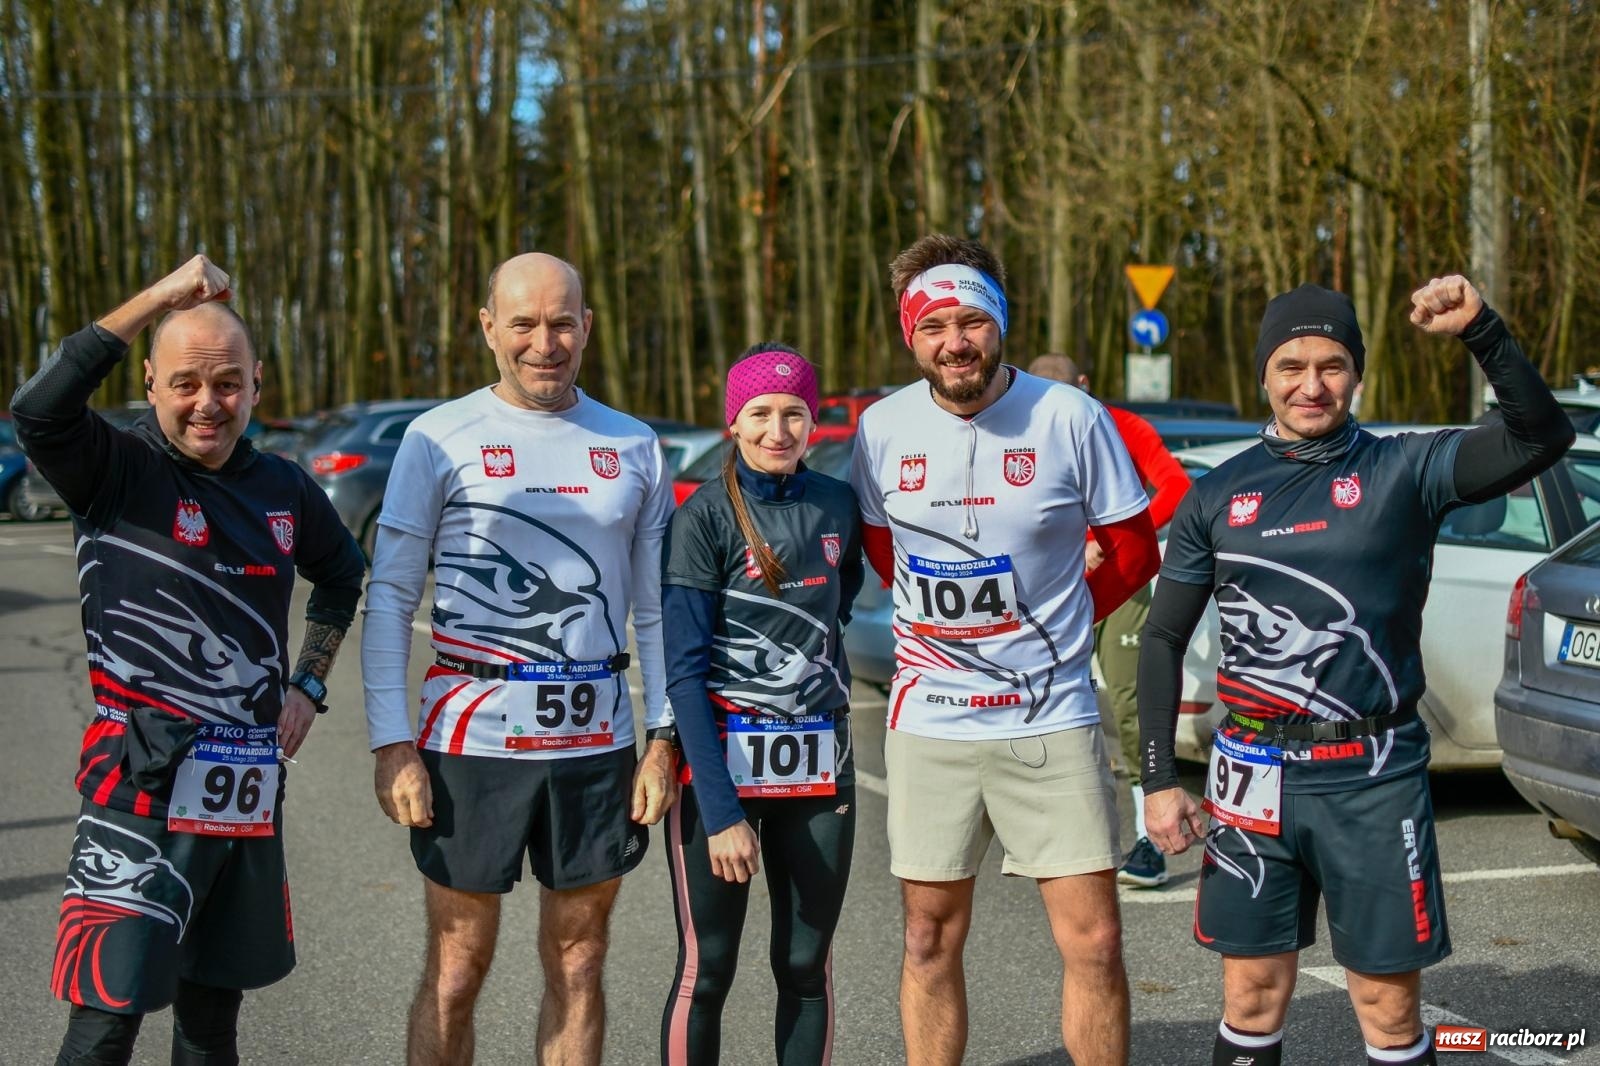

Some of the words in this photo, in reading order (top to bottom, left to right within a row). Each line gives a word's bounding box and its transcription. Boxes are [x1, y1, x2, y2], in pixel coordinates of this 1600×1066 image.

[959, 280, 988, 292] SILESIA
[959, 285, 998, 305] MARATHON
[925, 560, 940, 570] BIEG
[941, 559, 997, 571] TWARDZIELA
[916, 576, 1007, 620] 104
[438, 656, 465, 671] Kalenji
[522, 664, 534, 673] XII
[536, 665, 556, 673] BIEG
[536, 682, 596, 728] 59
[214, 726, 244, 738] PKO
[198, 743, 210, 752] XII
[212, 746, 232, 754] BIEG
[234, 747, 273, 756] TWARDZIELA
[748, 734, 819, 777] 101
[1148, 740, 1156, 773] IPSTA
[1216, 755, 1254, 807] 97
[202, 765, 263, 814] 96
[835, 804, 849, 814] 4F
[204, 823, 236, 832] Racibórz
